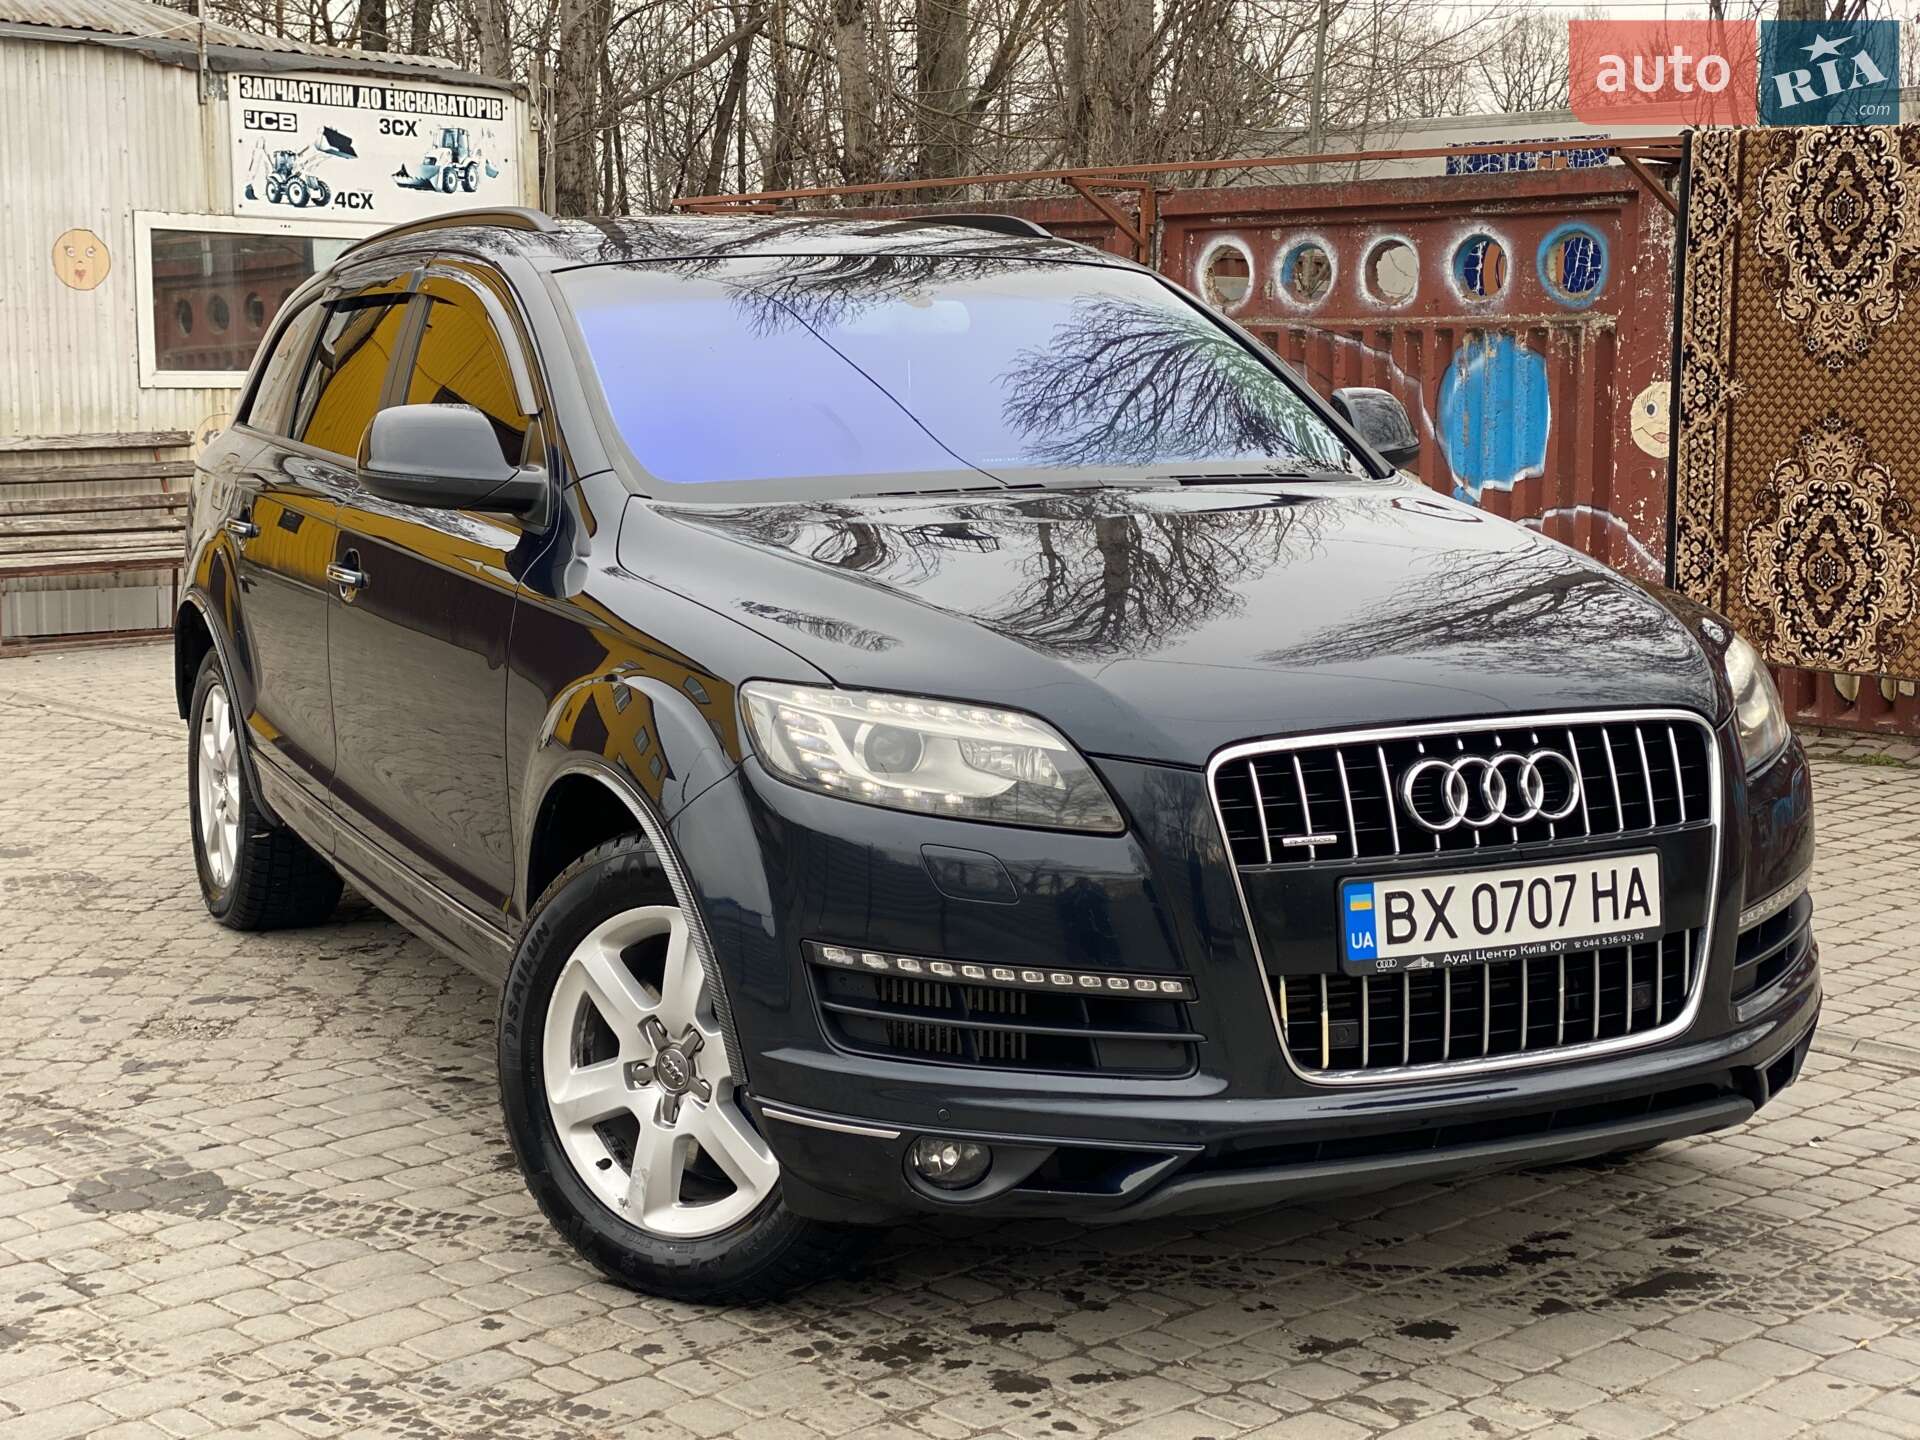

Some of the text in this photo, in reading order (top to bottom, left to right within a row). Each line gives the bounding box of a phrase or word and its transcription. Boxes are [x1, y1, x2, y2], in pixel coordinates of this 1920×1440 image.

[240, 76, 503, 120] ЗАПЧАСТИНИ ДО ЕКСКАВАТОРІВ
[245, 111, 297, 132] JCB
[379, 118, 418, 137] 3CX
[334, 191, 374, 210] 4CX
[1383, 867, 1651, 945] BX 0707 HA
[1351, 931, 1375, 949] UA
[1443, 932, 1645, 965] Ауді Центр Київ Юг 044 536-92-92
